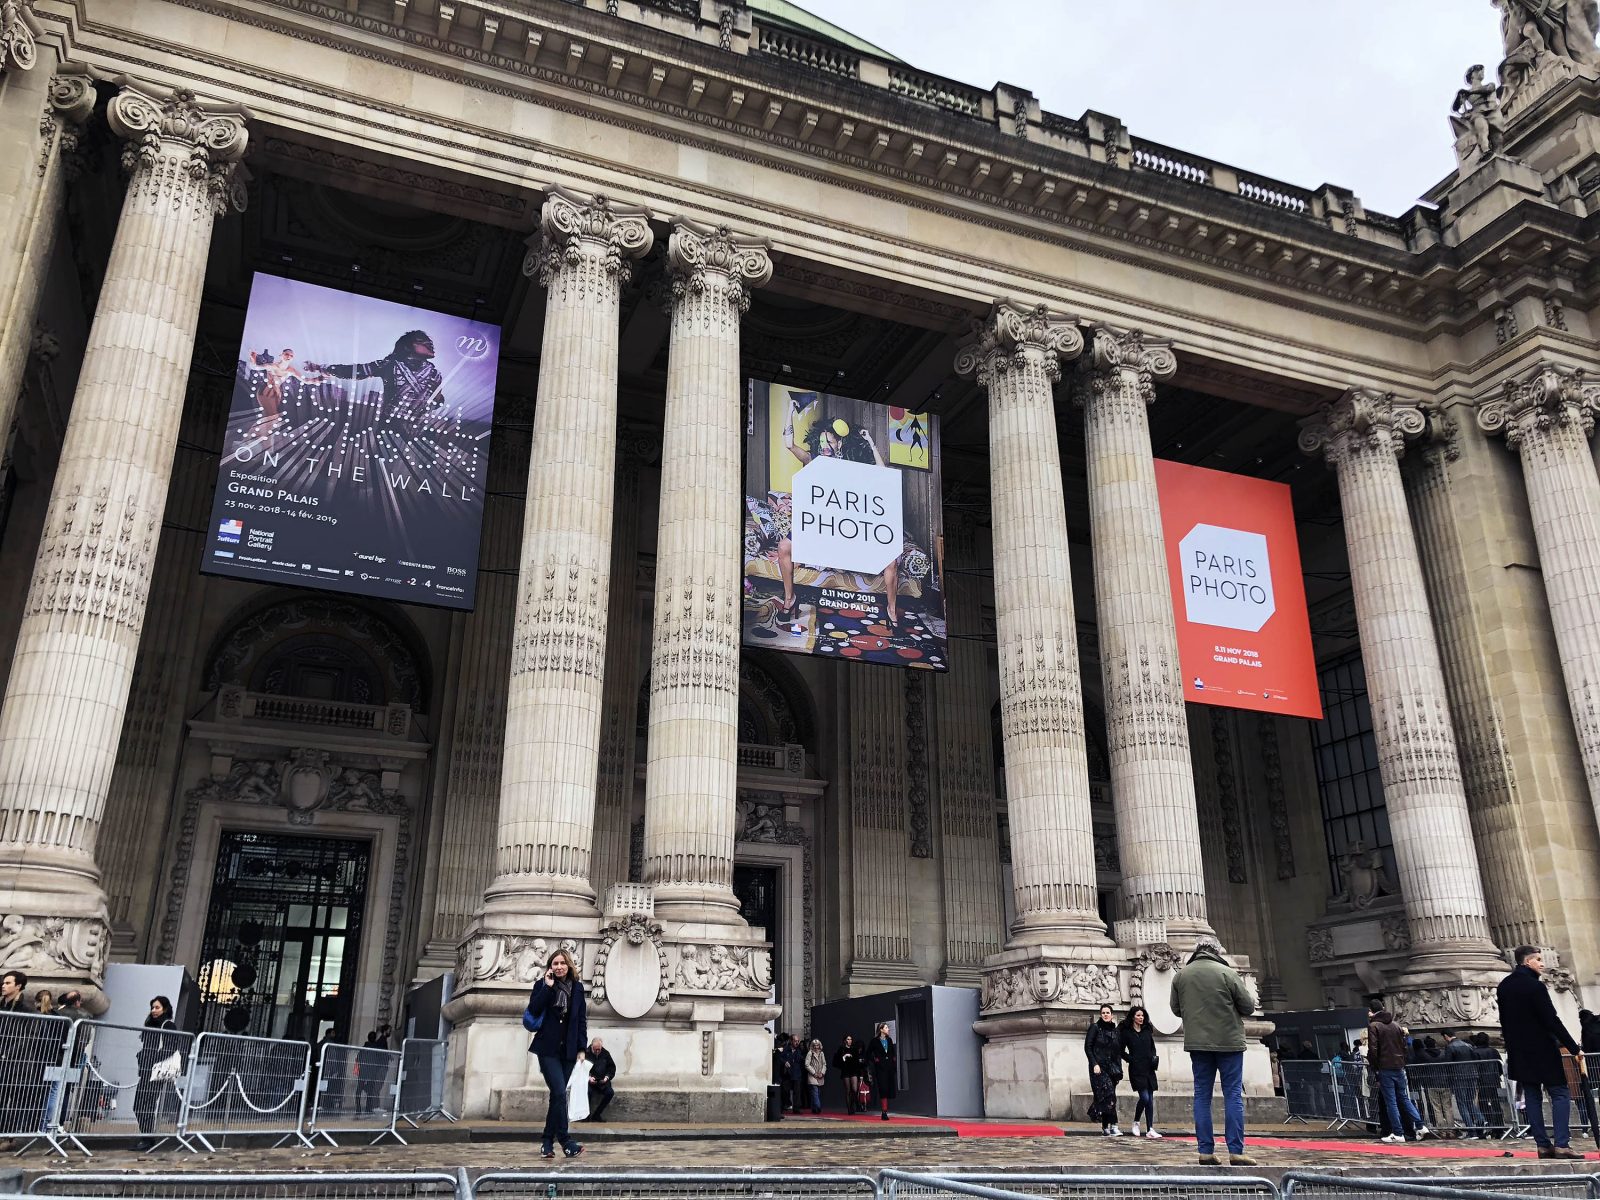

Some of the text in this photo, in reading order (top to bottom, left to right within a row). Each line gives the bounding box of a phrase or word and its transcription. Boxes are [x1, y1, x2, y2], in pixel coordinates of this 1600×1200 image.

[235, 446, 279, 467] ON
[306, 457, 365, 482] THE
[230, 470, 278, 484] Exposition
[228, 482, 319, 506] GRAND PALAIS
[811, 485, 885, 516] PARIS
[224, 499, 236, 508] 23
[238, 502, 256, 510] nov.
[298, 510, 314, 520] fév.
[316, 514, 338, 526] 2019
[249, 528, 275, 538] National
[801, 512, 894, 545] PHOTO
[247, 541, 272, 551] Gallery
[248, 535, 273, 544] Portrait
[447, 566, 467, 575] BOSS
[1195, 551, 1257, 578] PARIS
[822, 588, 876, 603] 8.11 NOV 2018
[1191, 575, 1266, 604] PHOTO
[819, 599, 879, 614] GRAND PALAIS
[1213, 655, 1262, 668] GRAND PALAIS
[1243, 650, 1259, 658] 2018
